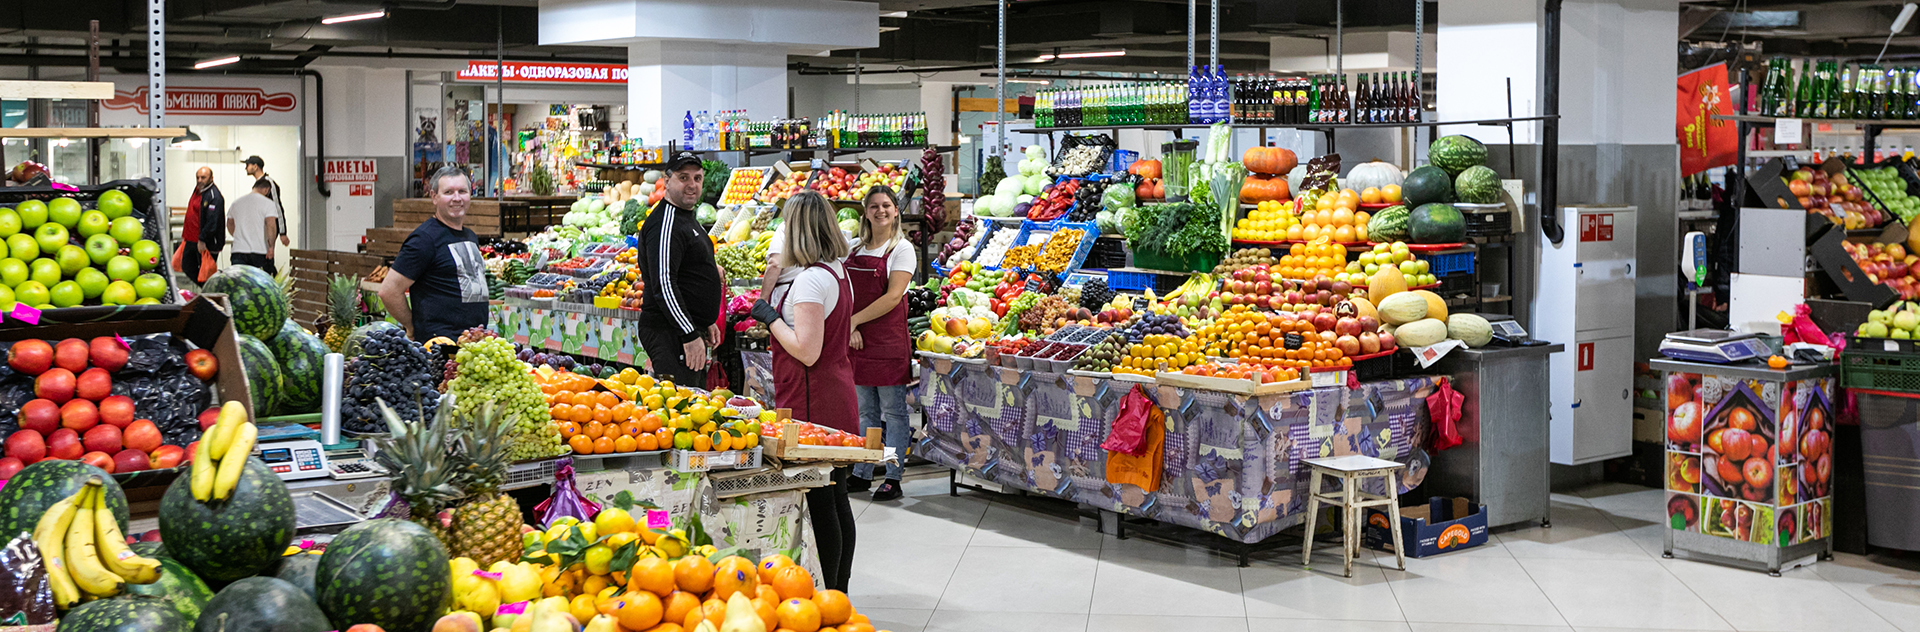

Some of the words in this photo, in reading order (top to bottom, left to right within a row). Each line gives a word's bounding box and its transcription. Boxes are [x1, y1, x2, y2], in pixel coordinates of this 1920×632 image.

[520, 65, 608, 80] ОДНОРАЗОВАЯ
[146, 93, 217, 109] ЬМЕННАЯ
[222, 94, 257, 110] ЛАВКА
[585, 477, 615, 491] ZEN
[1440, 529, 1467, 544] CAPEGOLD
